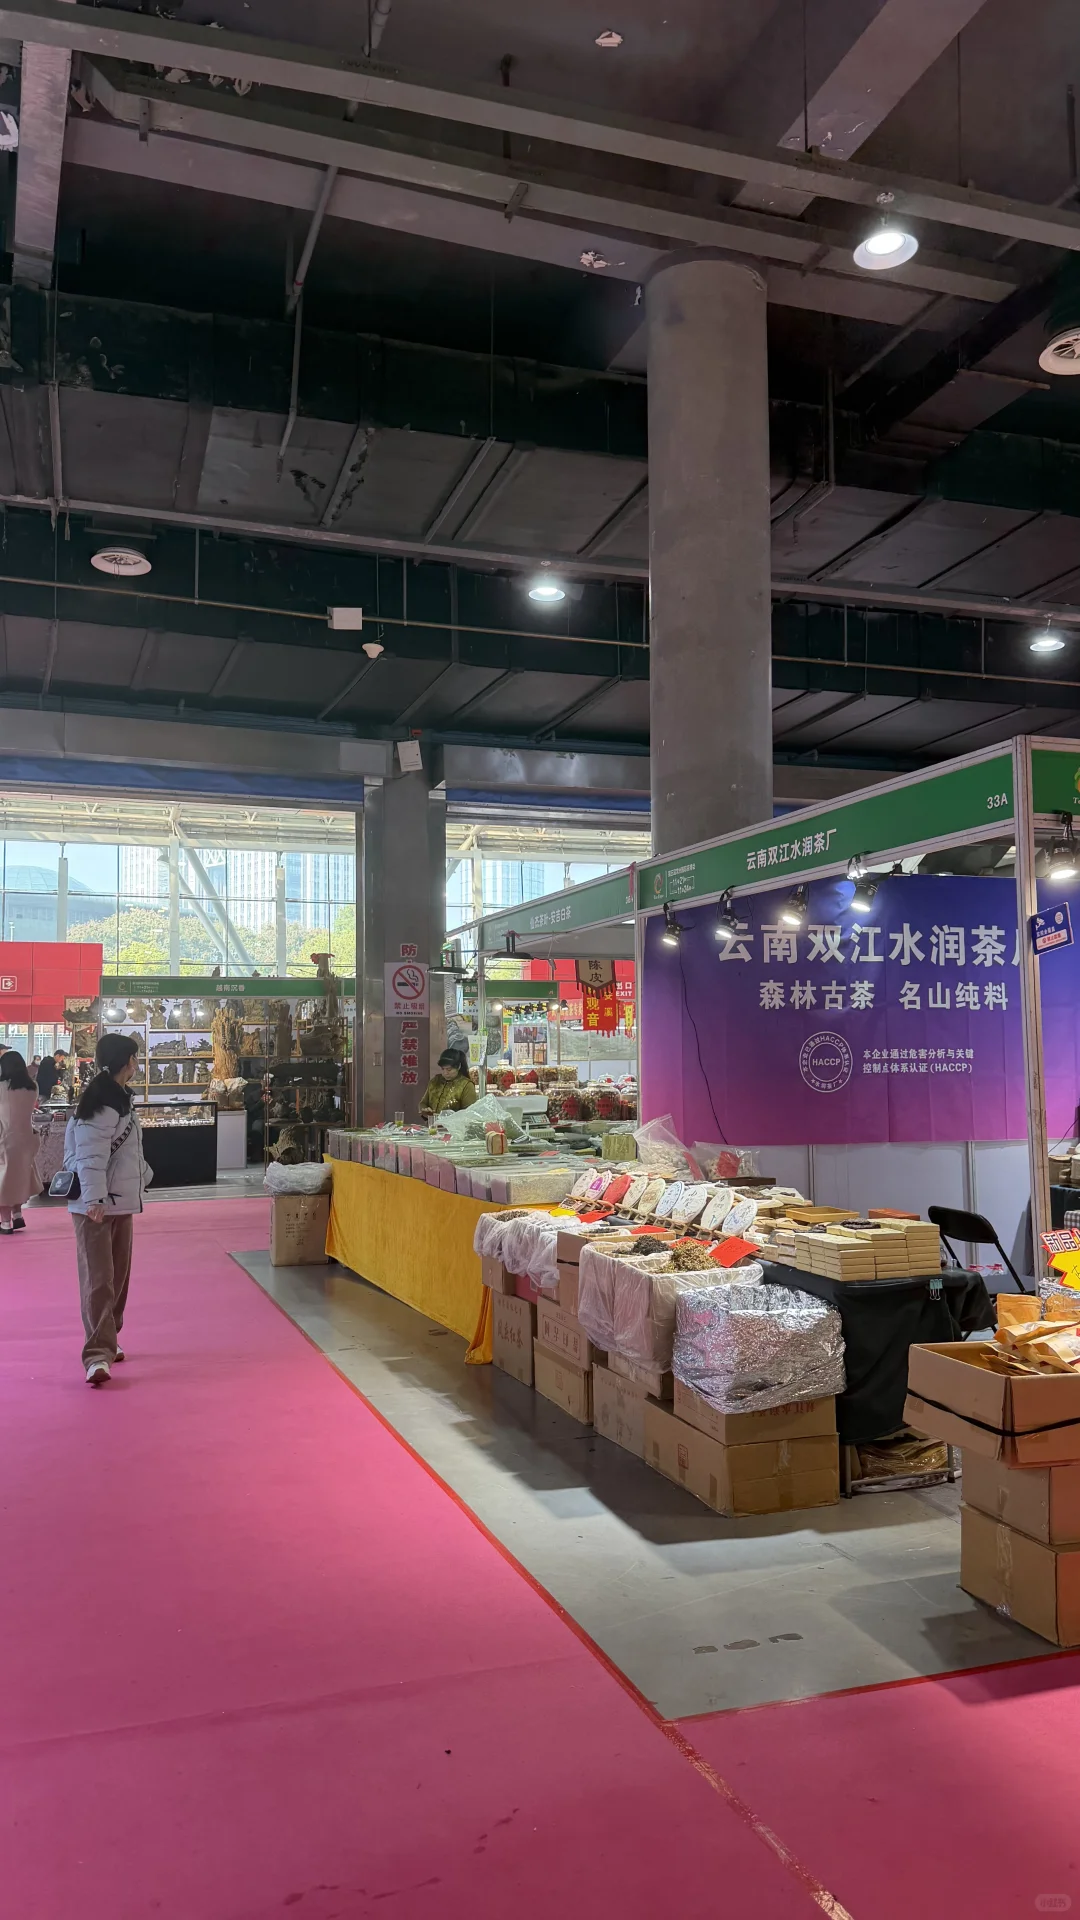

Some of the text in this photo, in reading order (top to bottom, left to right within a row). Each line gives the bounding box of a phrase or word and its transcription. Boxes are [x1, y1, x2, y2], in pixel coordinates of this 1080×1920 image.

[987, 795, 1008, 809] 33A
[746, 829, 837, 871] 云南双江水润茶厂
[616, 982, 632, 990] 出口
[759, 980, 1009, 1011] 森林古茶 名山纯料
[394, 1002, 425, 1010] 禁止吸烟
[401, 1021, 418, 1084] 严禁堆放
[863, 1048, 974, 1060] 本企业通过危害分析与关键
[812, 1058, 841, 1066] HACCP
